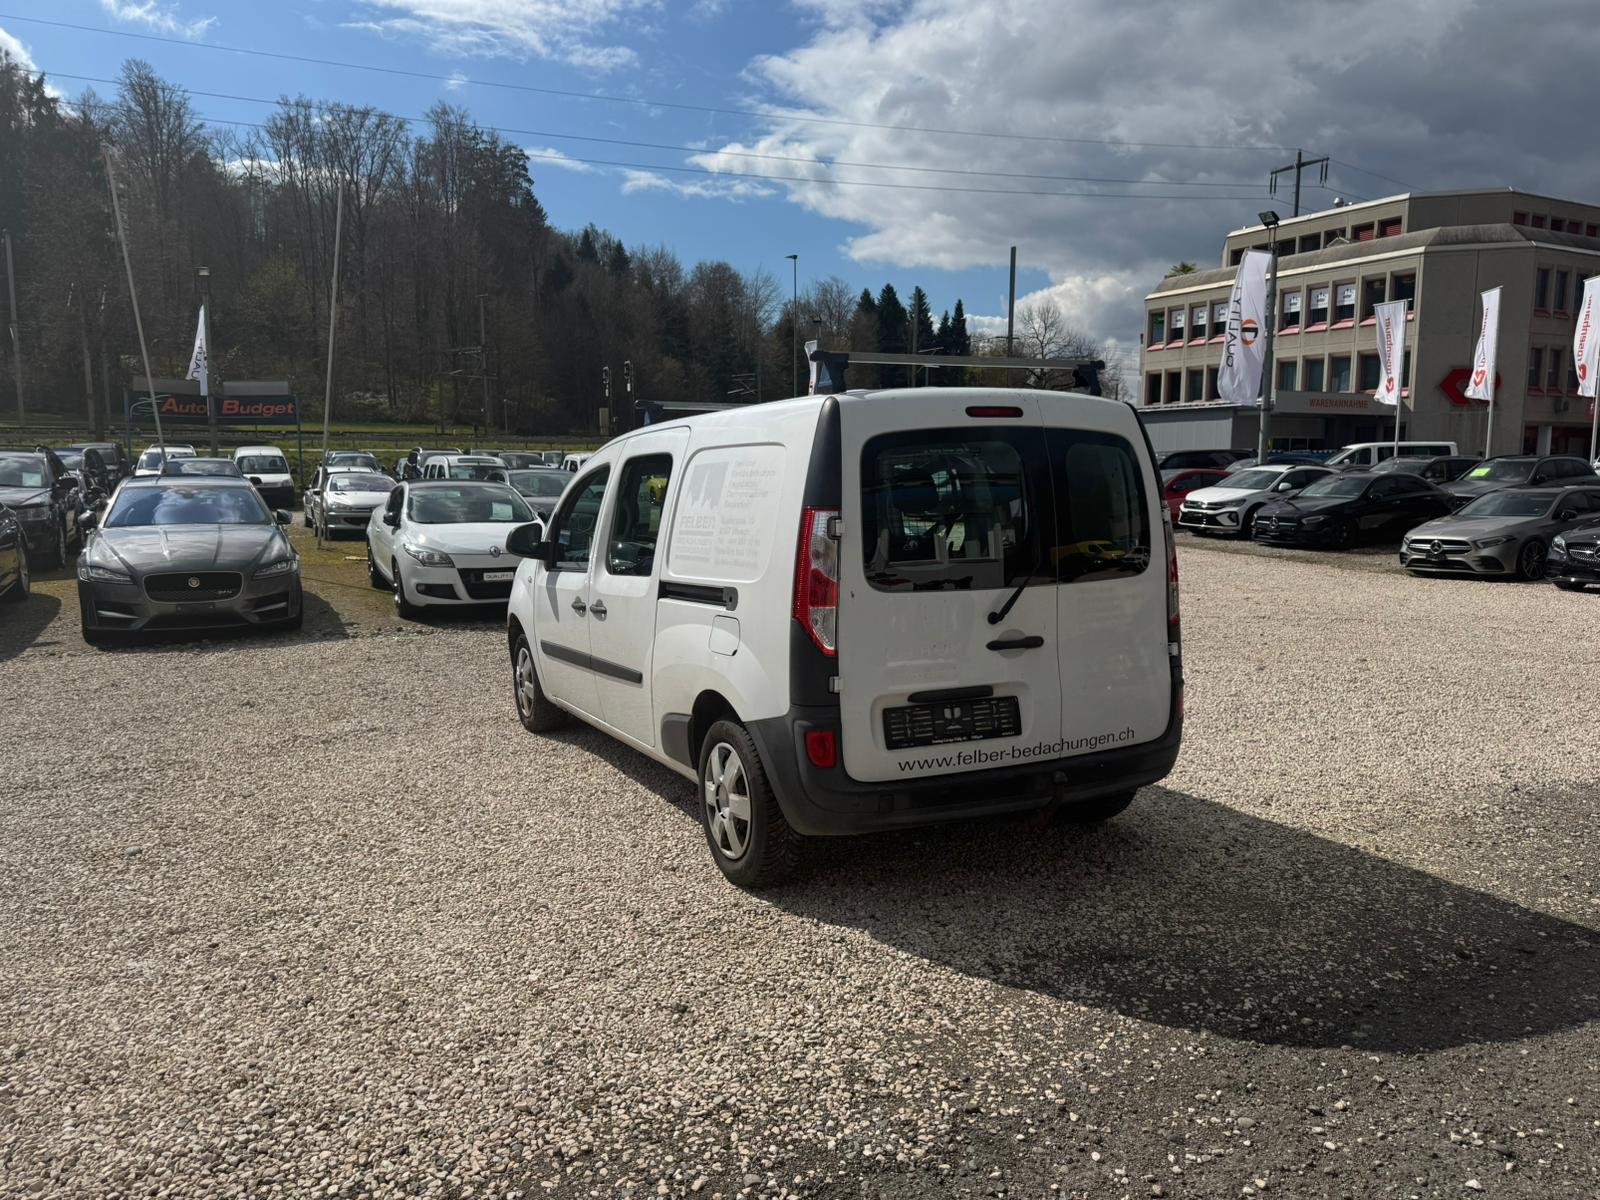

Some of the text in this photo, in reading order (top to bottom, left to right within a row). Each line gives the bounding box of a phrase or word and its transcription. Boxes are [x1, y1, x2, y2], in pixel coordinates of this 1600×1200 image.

[162, 398, 296, 416] Auto Budget
[1311, 399, 1369, 408] WARENANNAHME
[897, 727, 1135, 771] www.felber-bedachungen.ch
